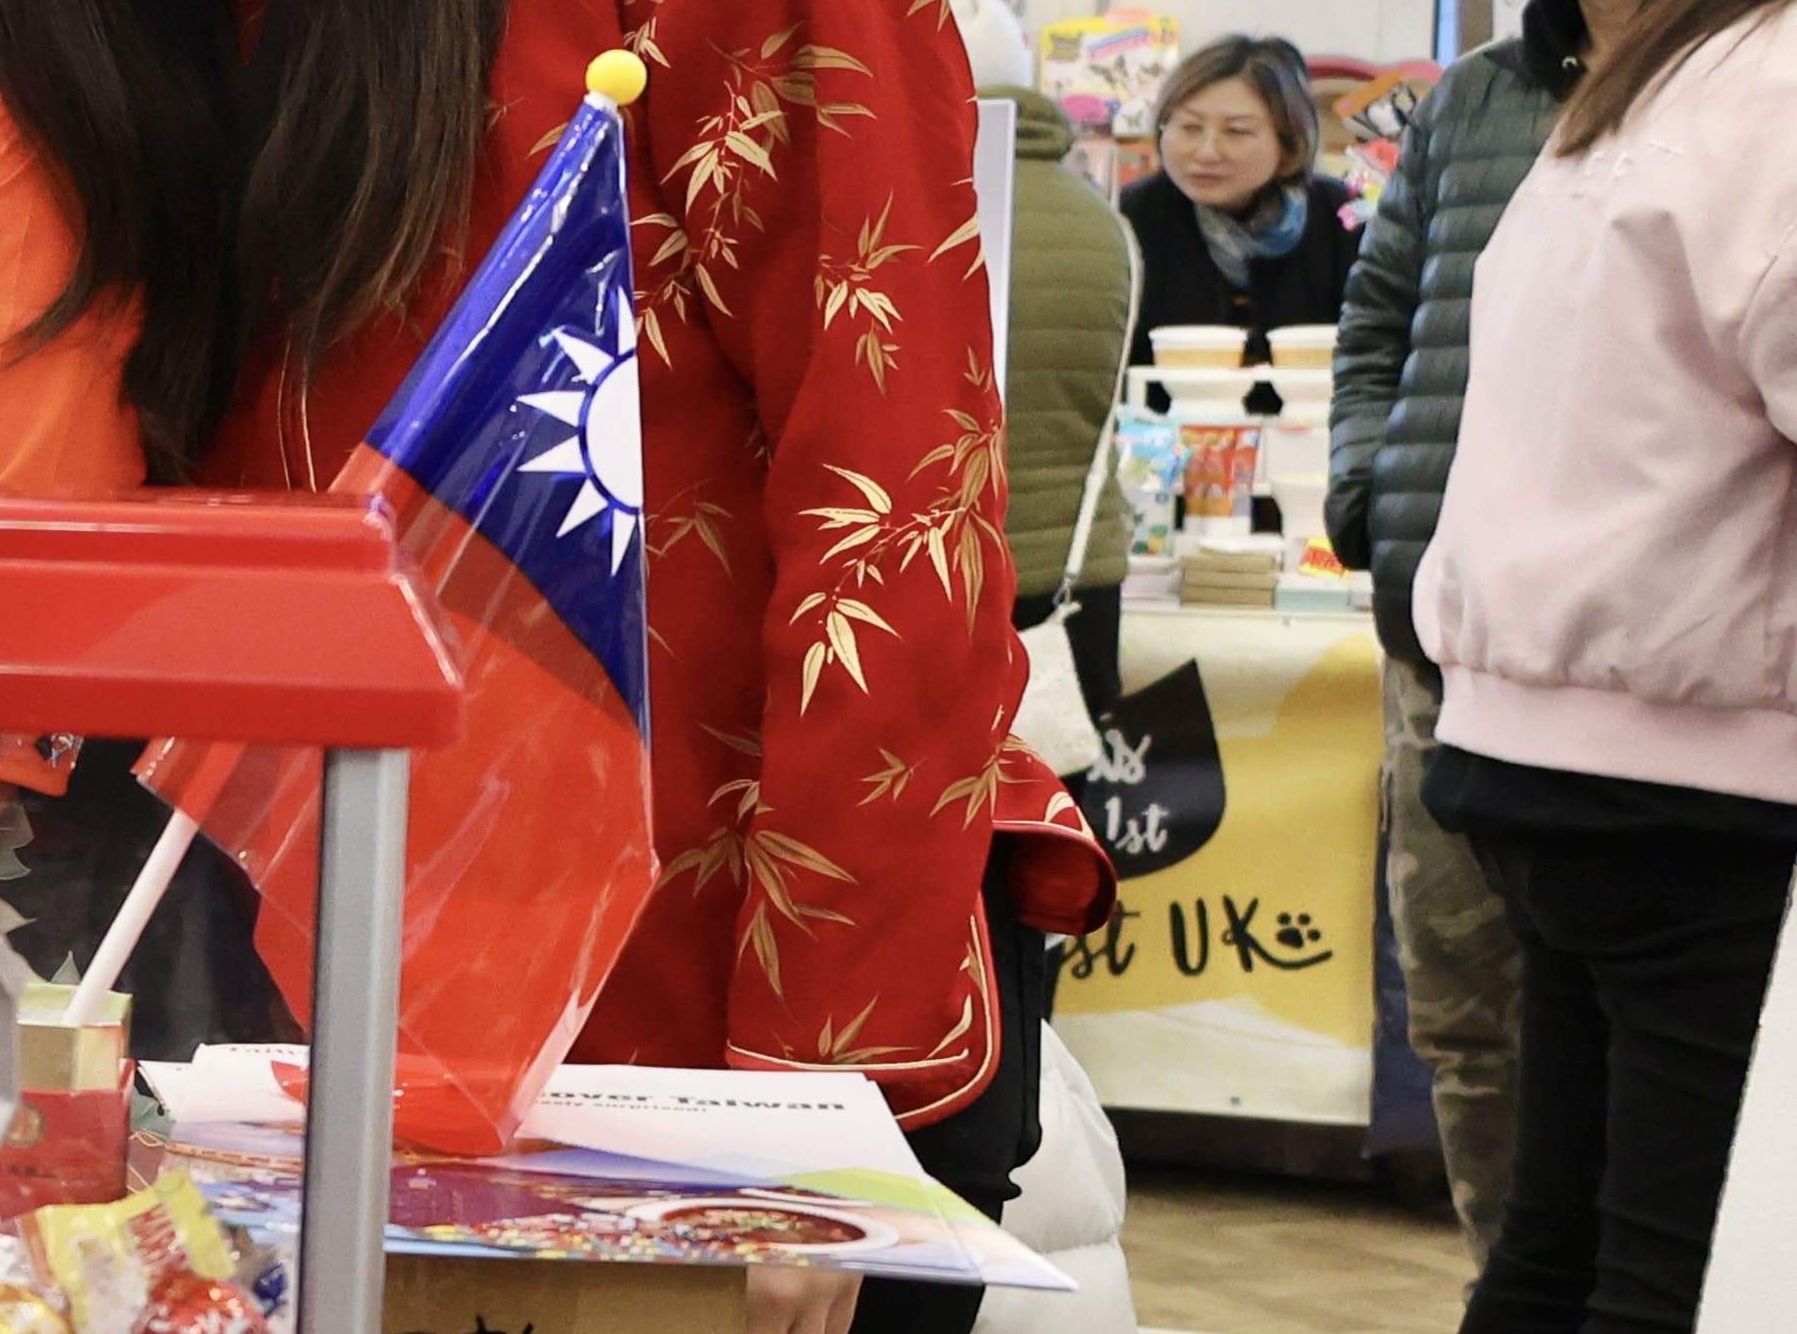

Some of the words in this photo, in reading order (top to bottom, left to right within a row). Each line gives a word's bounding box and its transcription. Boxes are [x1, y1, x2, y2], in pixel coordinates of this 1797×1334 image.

[1105, 795, 1170, 855] 1st
[1170, 895, 1295, 976] UK
[668, 1094, 846, 1110] Taiwan
